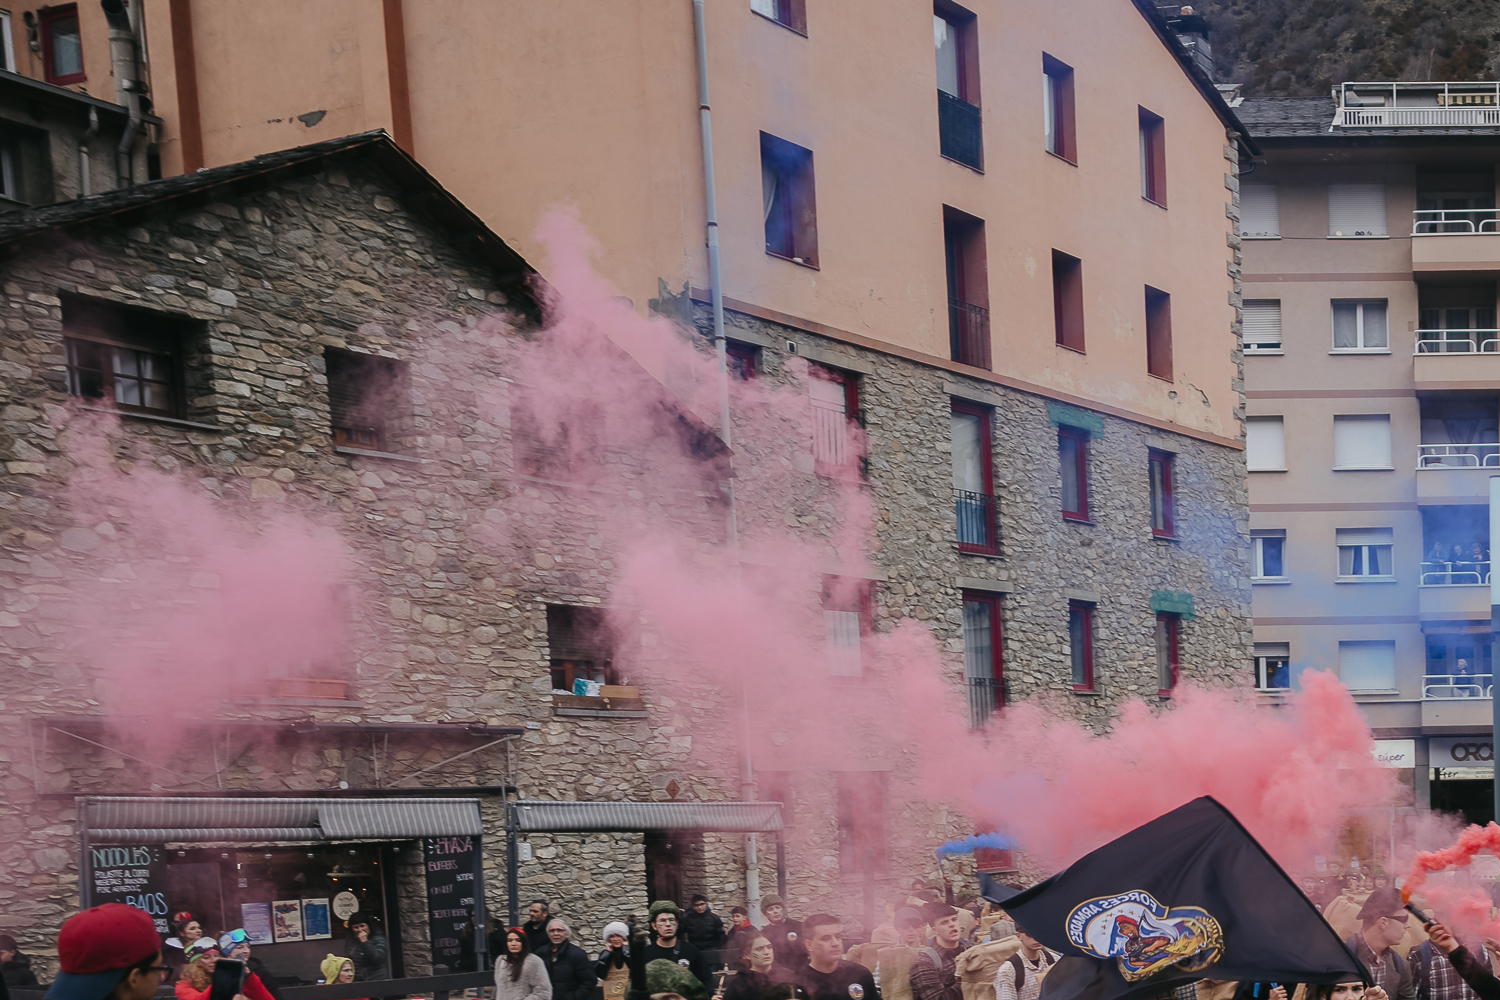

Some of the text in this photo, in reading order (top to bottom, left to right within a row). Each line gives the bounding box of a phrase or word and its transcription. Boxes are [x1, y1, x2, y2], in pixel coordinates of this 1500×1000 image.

[1451, 742, 1494, 762] ORO
[93, 846, 151, 868] NOODLES
[126, 893, 168, 915] BAOS
